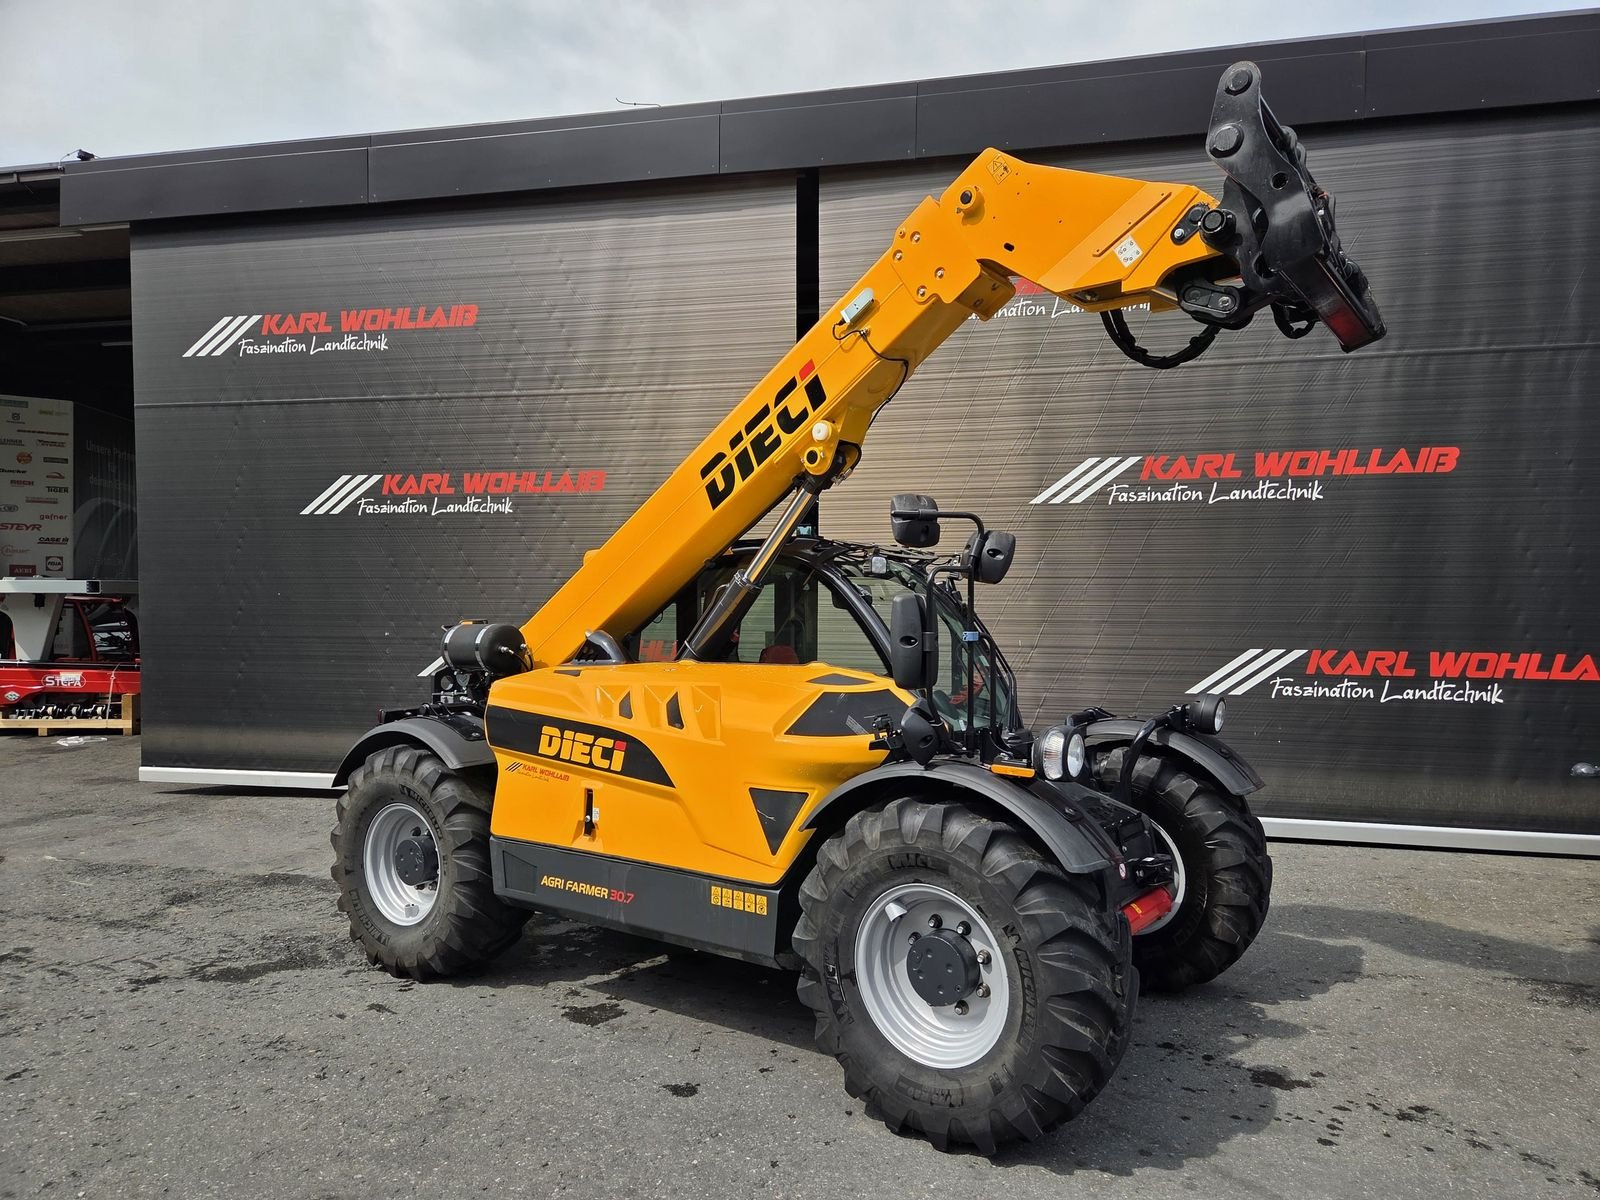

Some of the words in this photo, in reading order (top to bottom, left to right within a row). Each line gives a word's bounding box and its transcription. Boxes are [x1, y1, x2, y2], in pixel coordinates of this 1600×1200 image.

[262, 311, 332, 336] KARL
[340, 304, 479, 332] WOHLLAIB
[239, 336, 307, 357] Faszination
[310, 333, 389, 355] Landtechnik
[1139, 453, 1242, 481] KARL
[1254, 446, 1461, 477] WOHLLAIB
[382, 473, 455, 495] KARL
[463, 470, 608, 494] WOHLLAIB
[1107, 481, 1203, 505] Faszination
[1208, 479, 1324, 505] Landtechnik
[357, 497, 428, 516] Faszination
[432, 496, 514, 516] Landtechnik
[0, 522, 43, 531] STEYR
[1305, 649, 1416, 677] KARL
[1429, 651, 1600, 681] WOHLLA
[1270, 677, 1374, 700] Faszination
[1380, 680, 1504, 704] Landtechnik
[541, 875, 564, 890] AGRI
[565, 880, 608, 899] FARMER
[609, 889, 634, 904] 30.7
